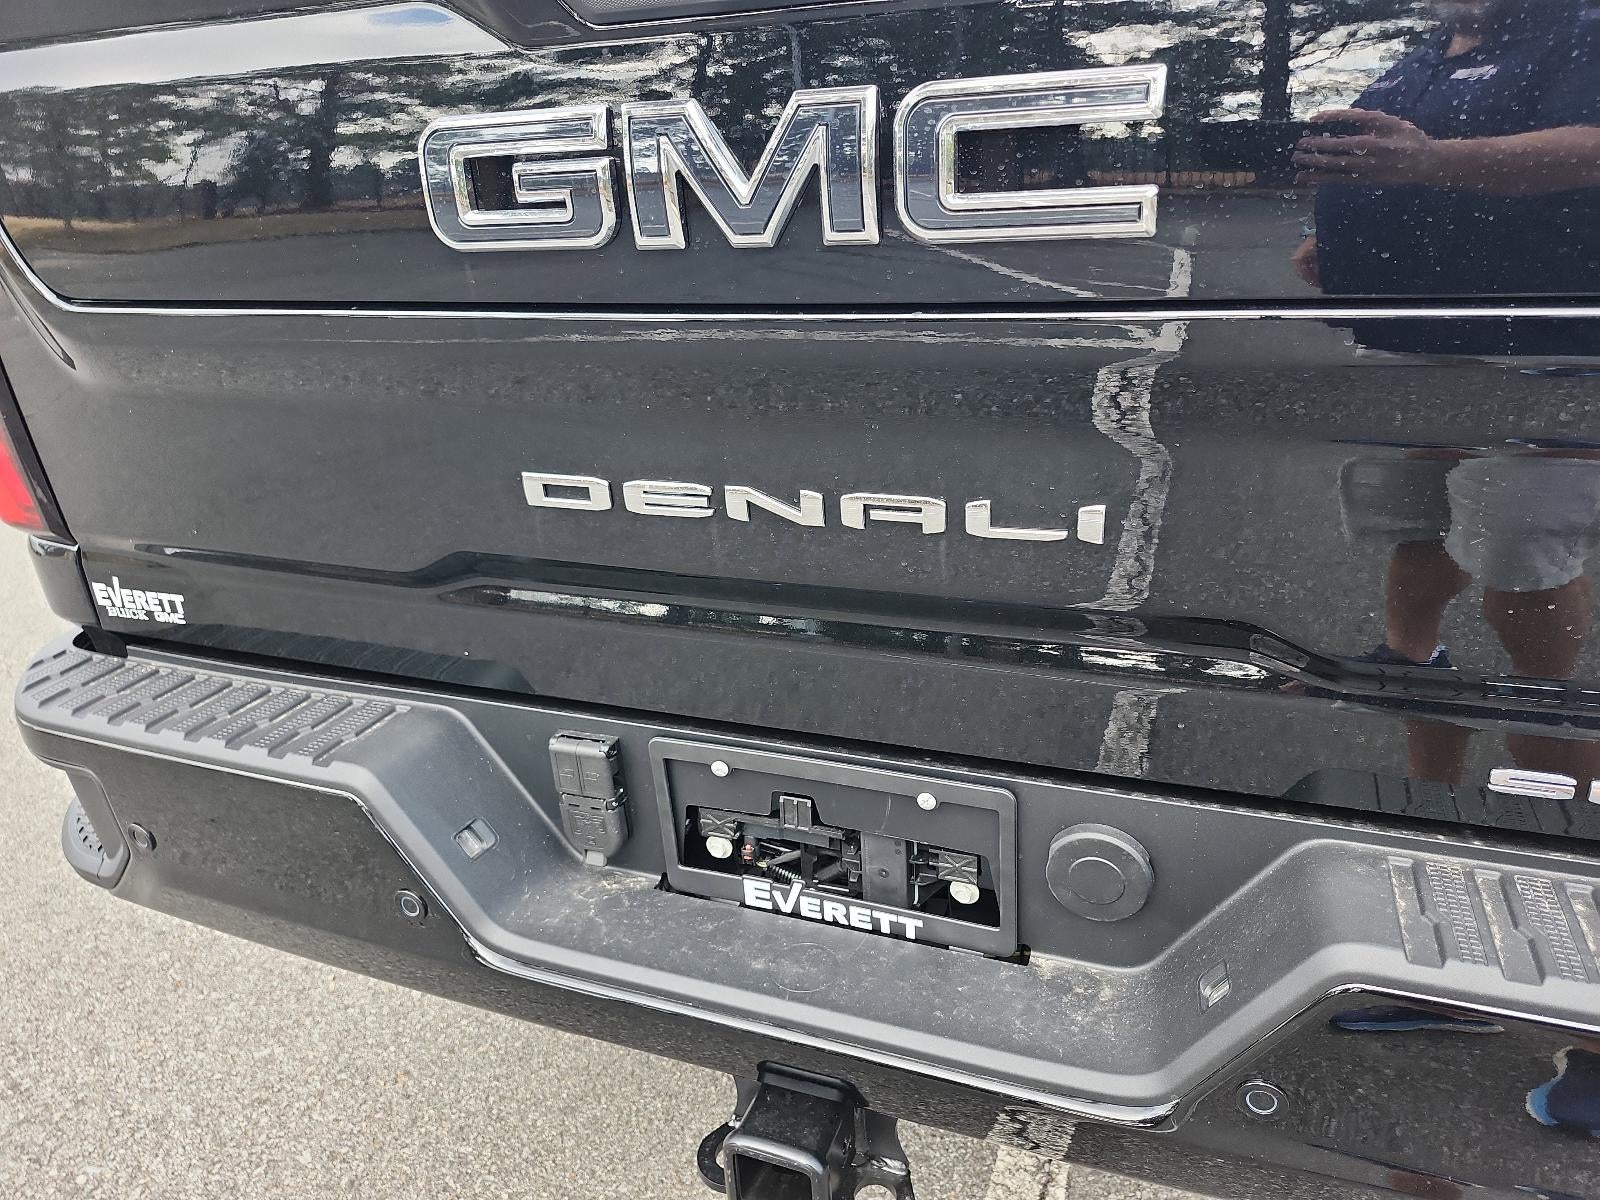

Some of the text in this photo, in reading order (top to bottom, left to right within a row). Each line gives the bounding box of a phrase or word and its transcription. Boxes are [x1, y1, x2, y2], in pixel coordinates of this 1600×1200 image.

[419, 63, 1167, 251] GMC
[521, 471, 1106, 544] DENALI
[92, 576, 184, 615] EVERETT
[106, 605, 186, 625] BUICK GMC
[743, 878, 923, 940] EVERETT
